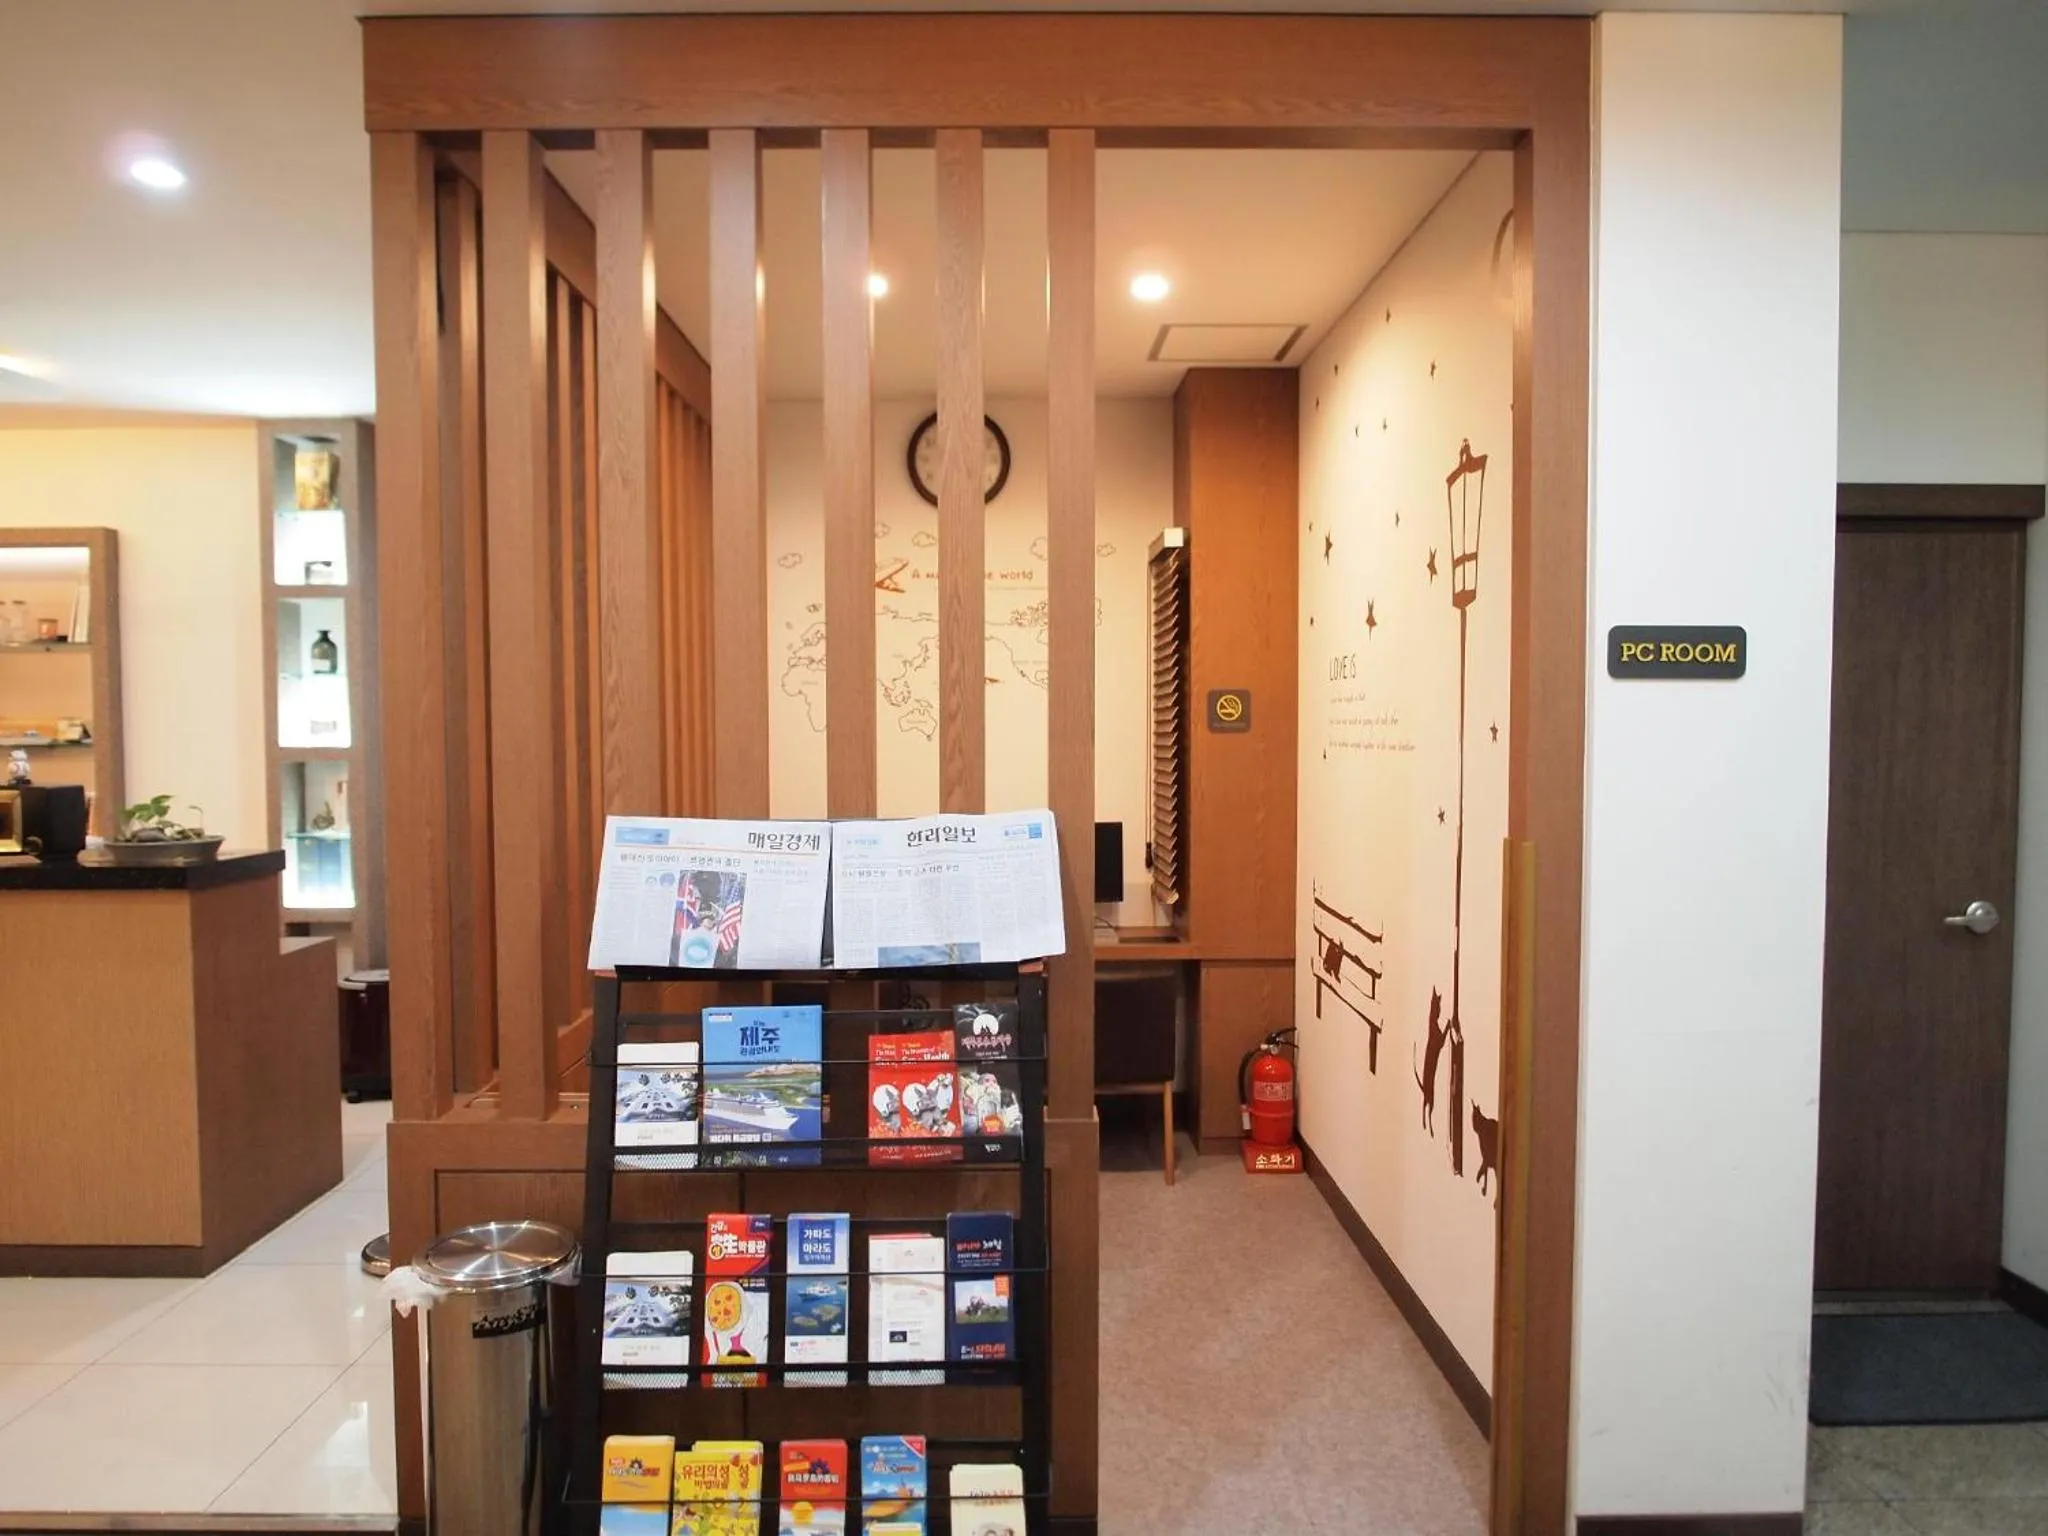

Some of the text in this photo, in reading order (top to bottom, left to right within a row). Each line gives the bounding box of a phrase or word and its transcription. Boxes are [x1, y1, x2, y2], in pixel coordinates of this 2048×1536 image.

[1621, 643, 1737, 663] PC ROOM
[1329, 655, 1348, 681] LOVE
[748, 832, 821, 850] 매일경제
[907, 825, 977, 847] 한라일보
[740, 1026, 780, 1046] 제주
[1256, 1153, 1295, 1165] 소화기
[682, 1463, 730, 1480] 유리의성
